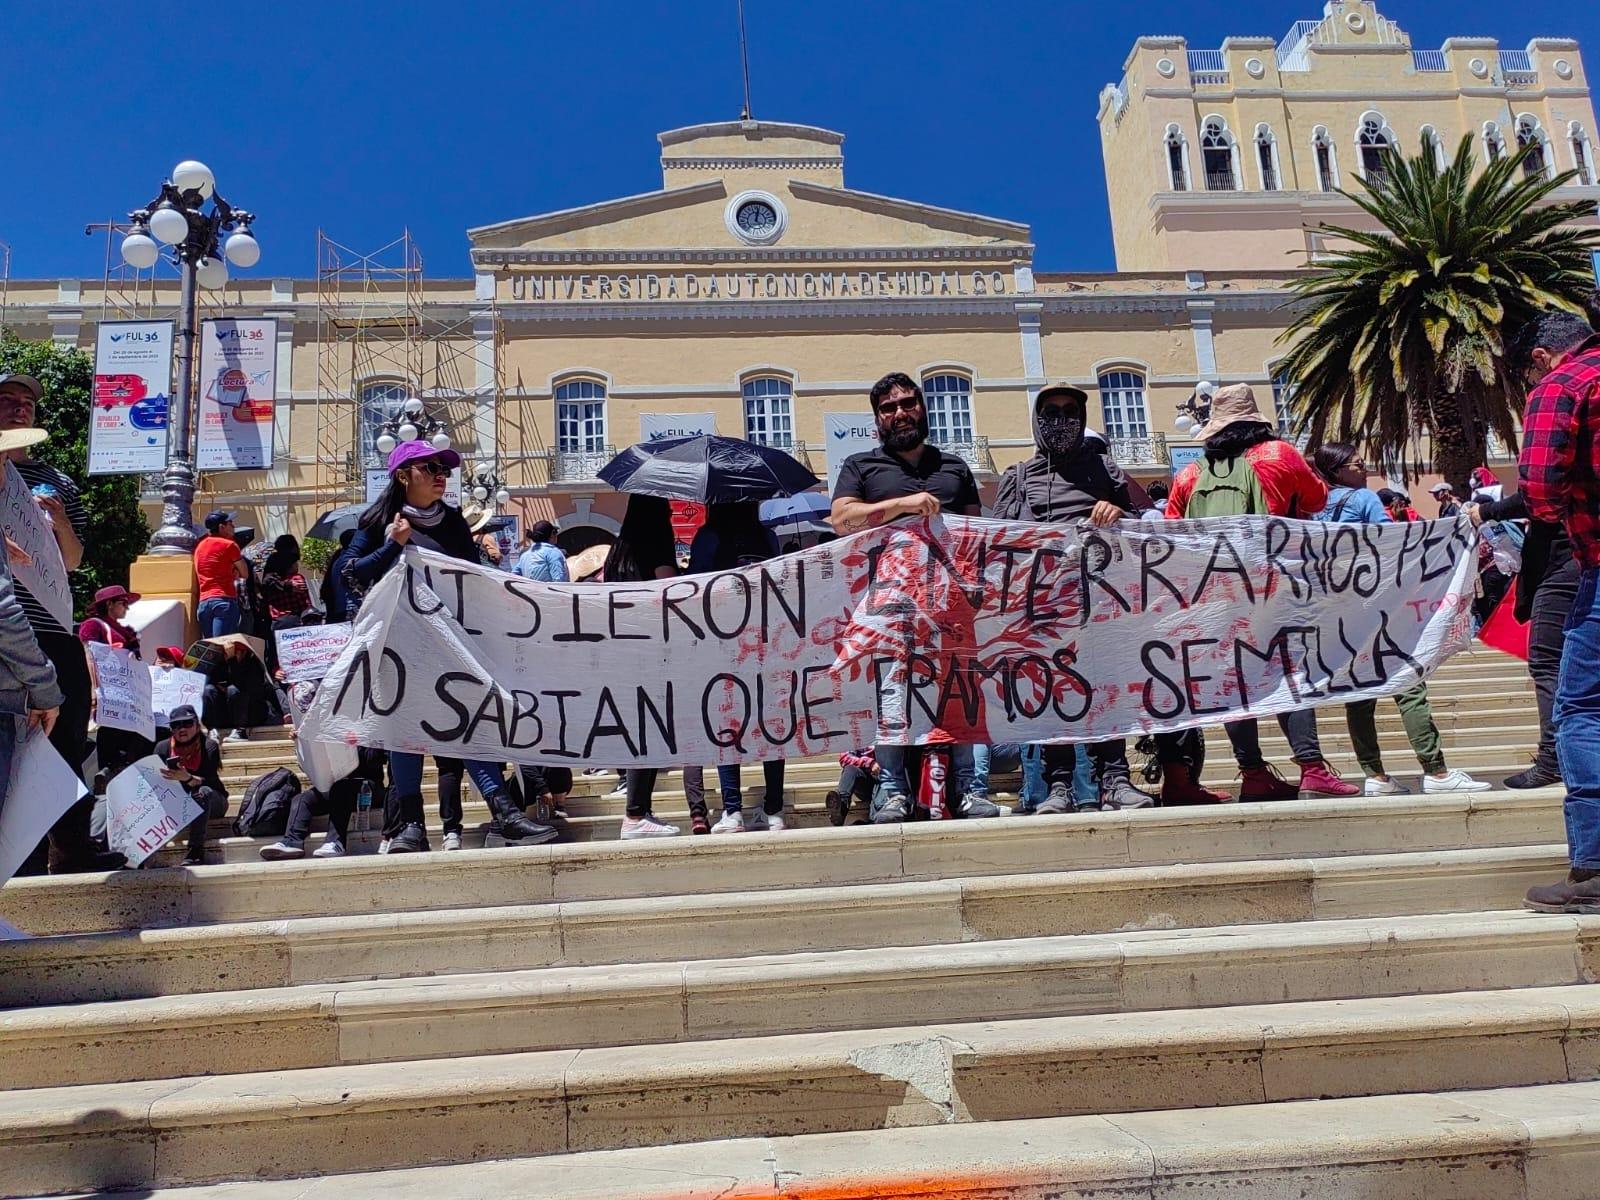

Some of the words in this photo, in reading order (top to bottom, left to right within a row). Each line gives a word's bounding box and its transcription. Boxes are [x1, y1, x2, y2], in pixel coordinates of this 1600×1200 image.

[511, 273, 698, 300] UNIVERSIDAD
[706, 272, 851, 299] AUTONOMA
[858, 271, 890, 296] DE
[895, 270, 1006, 297] HIDALGO
[126, 332, 143, 341] FUL
[145, 331, 159, 343] 36
[231, 329, 248, 338] FUL
[249, 329, 263, 340] 36
[218, 377, 255, 386] Lectura
[851, 427, 870, 438] FUL
[407, 560, 806, 642] UISIERON
[420, 671, 677, 760] SABIAN
[701, 664, 849, 754] QUE
[873, 648, 1093, 729] ERAMOS
[136, 815, 179, 853] UAEH
